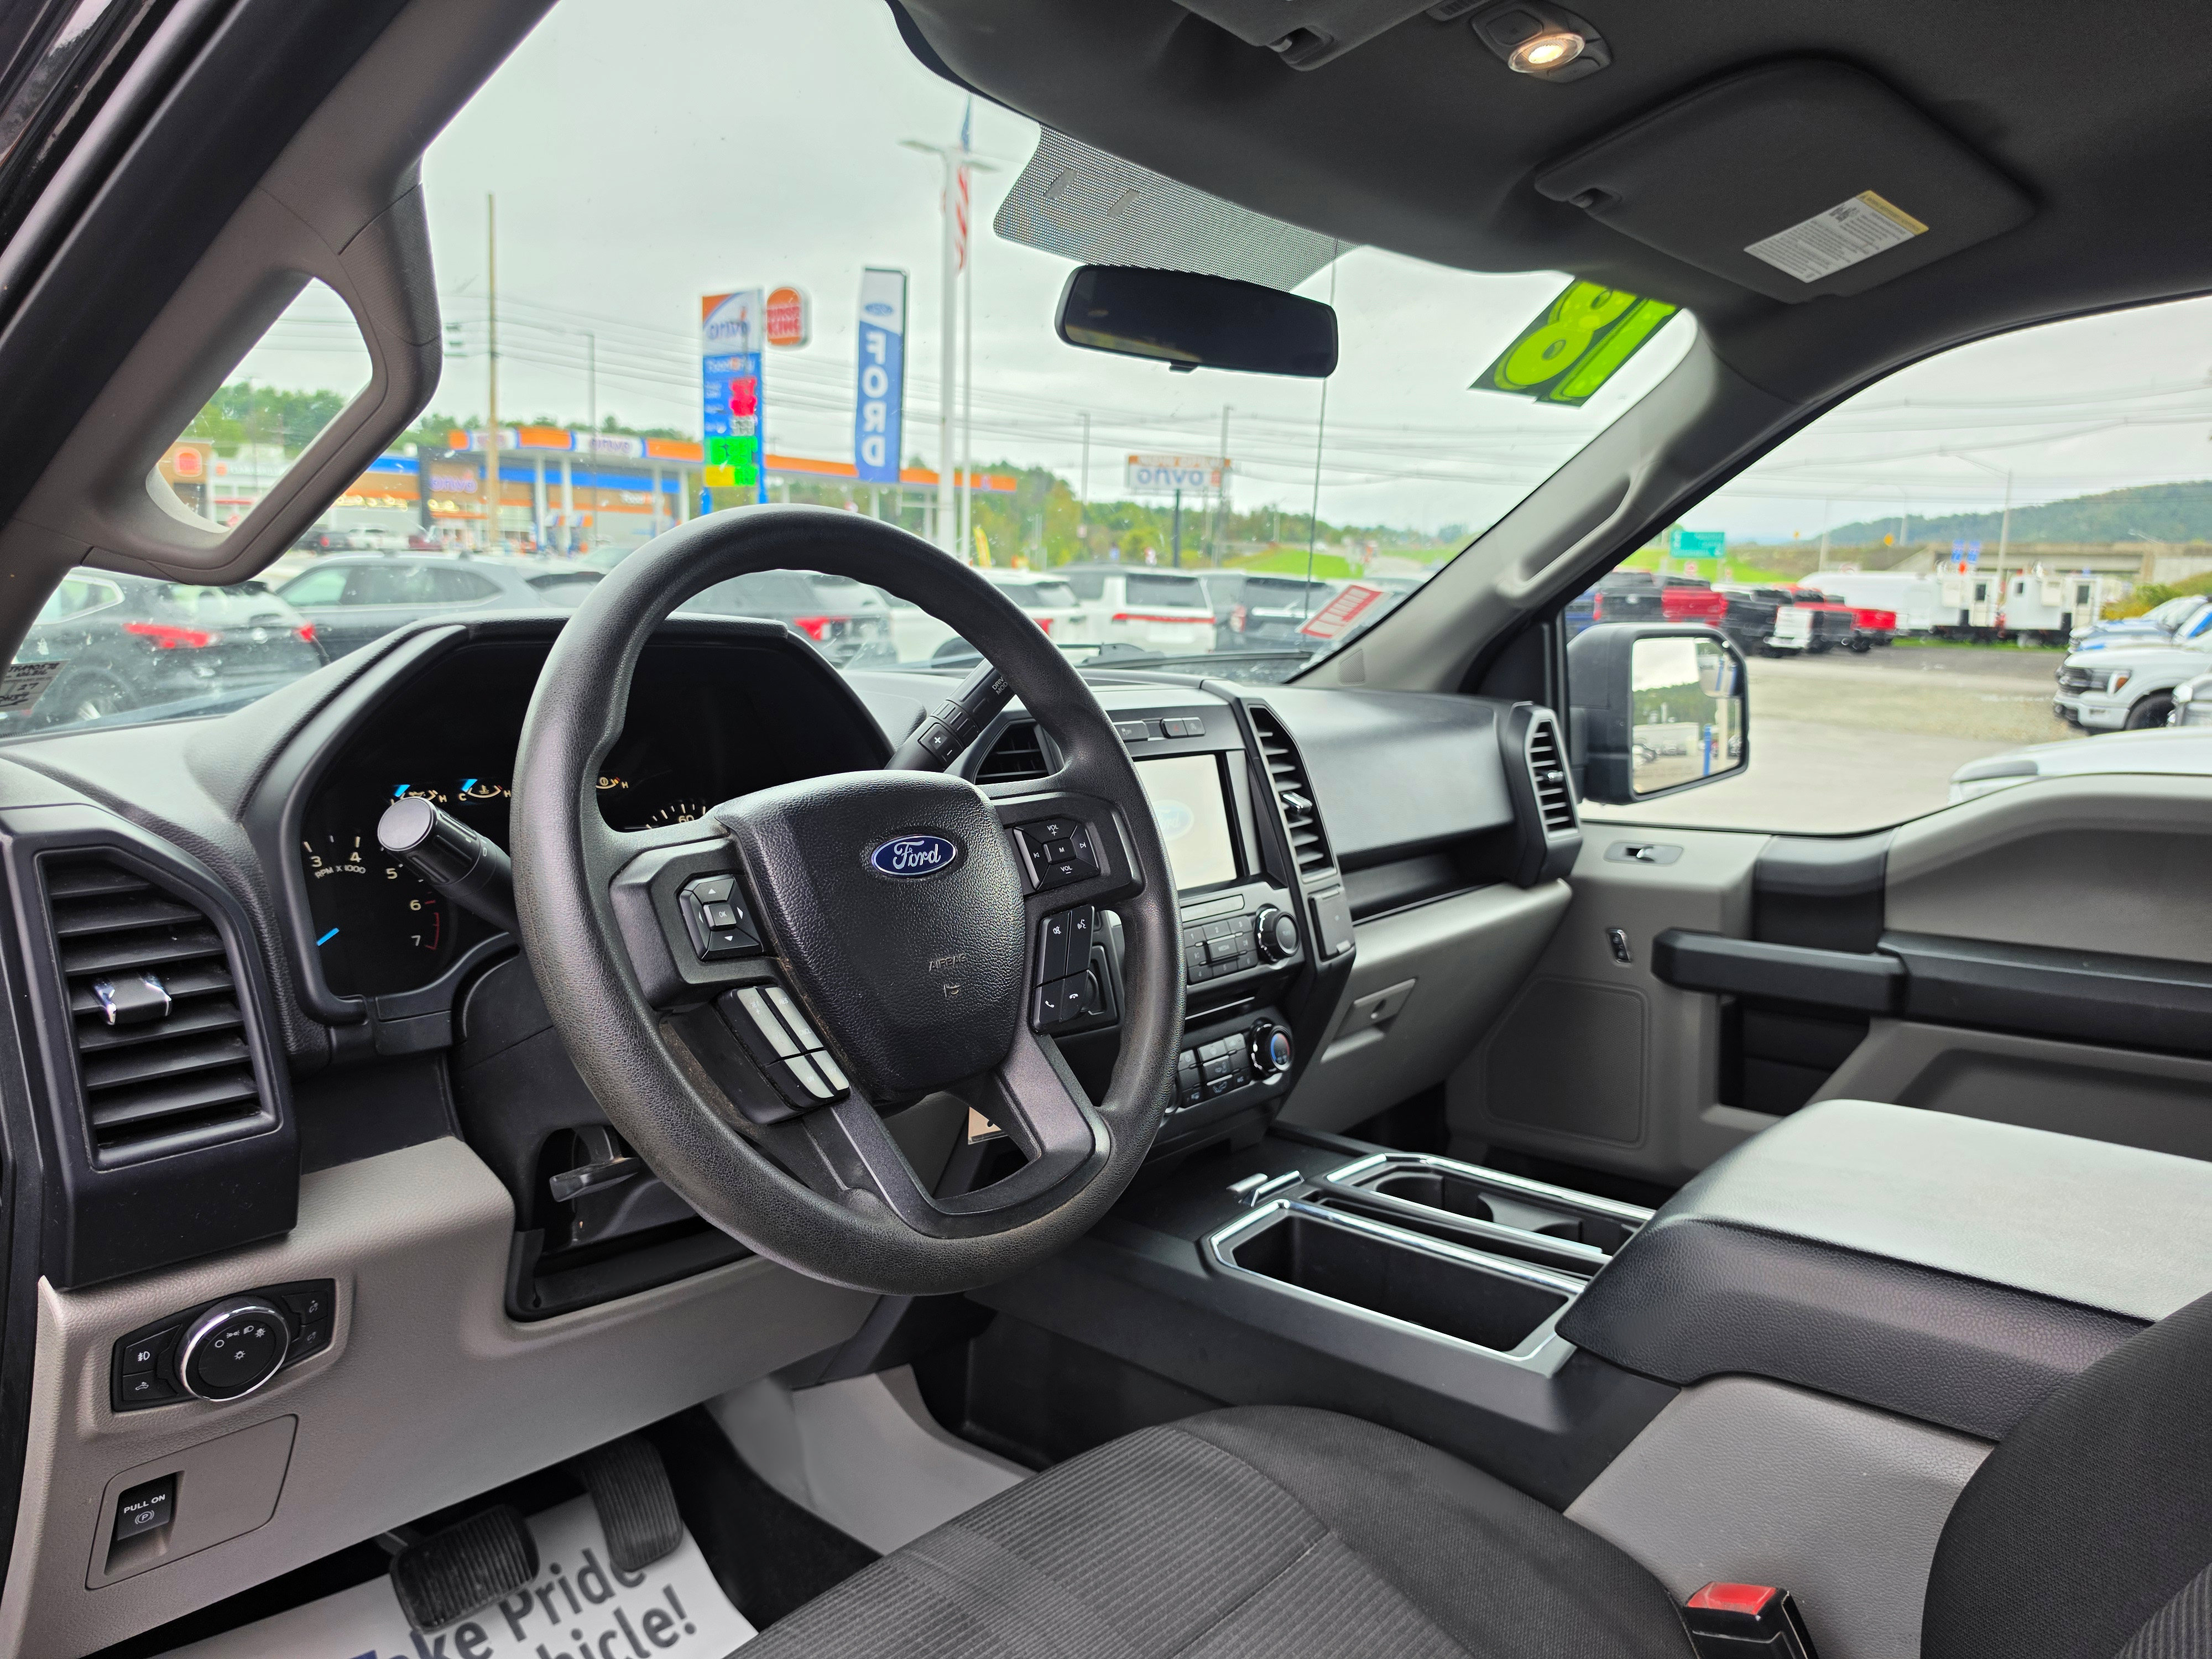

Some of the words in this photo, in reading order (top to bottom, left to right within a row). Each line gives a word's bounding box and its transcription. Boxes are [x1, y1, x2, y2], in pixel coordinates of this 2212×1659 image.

[992, 676, 1004, 690] DRIV
[995, 681, 1008, 695] MOD
[439, 794, 447, 803] H
[458, 792, 467, 801] C
[503, 789, 512, 797] H
[349, 852, 362, 863] 4
[893, 840, 941, 869] Ford
[311, 855, 322, 868] 3
[314, 867, 334, 879] RPM
[344, 864, 367, 874] 1000
[386, 868, 398, 879] 5
[409, 899, 422, 911] 6
[411, 935, 421, 946] 7
[123, 1501, 149, 1514] PULL
[151, 1494, 166, 1504] ON
